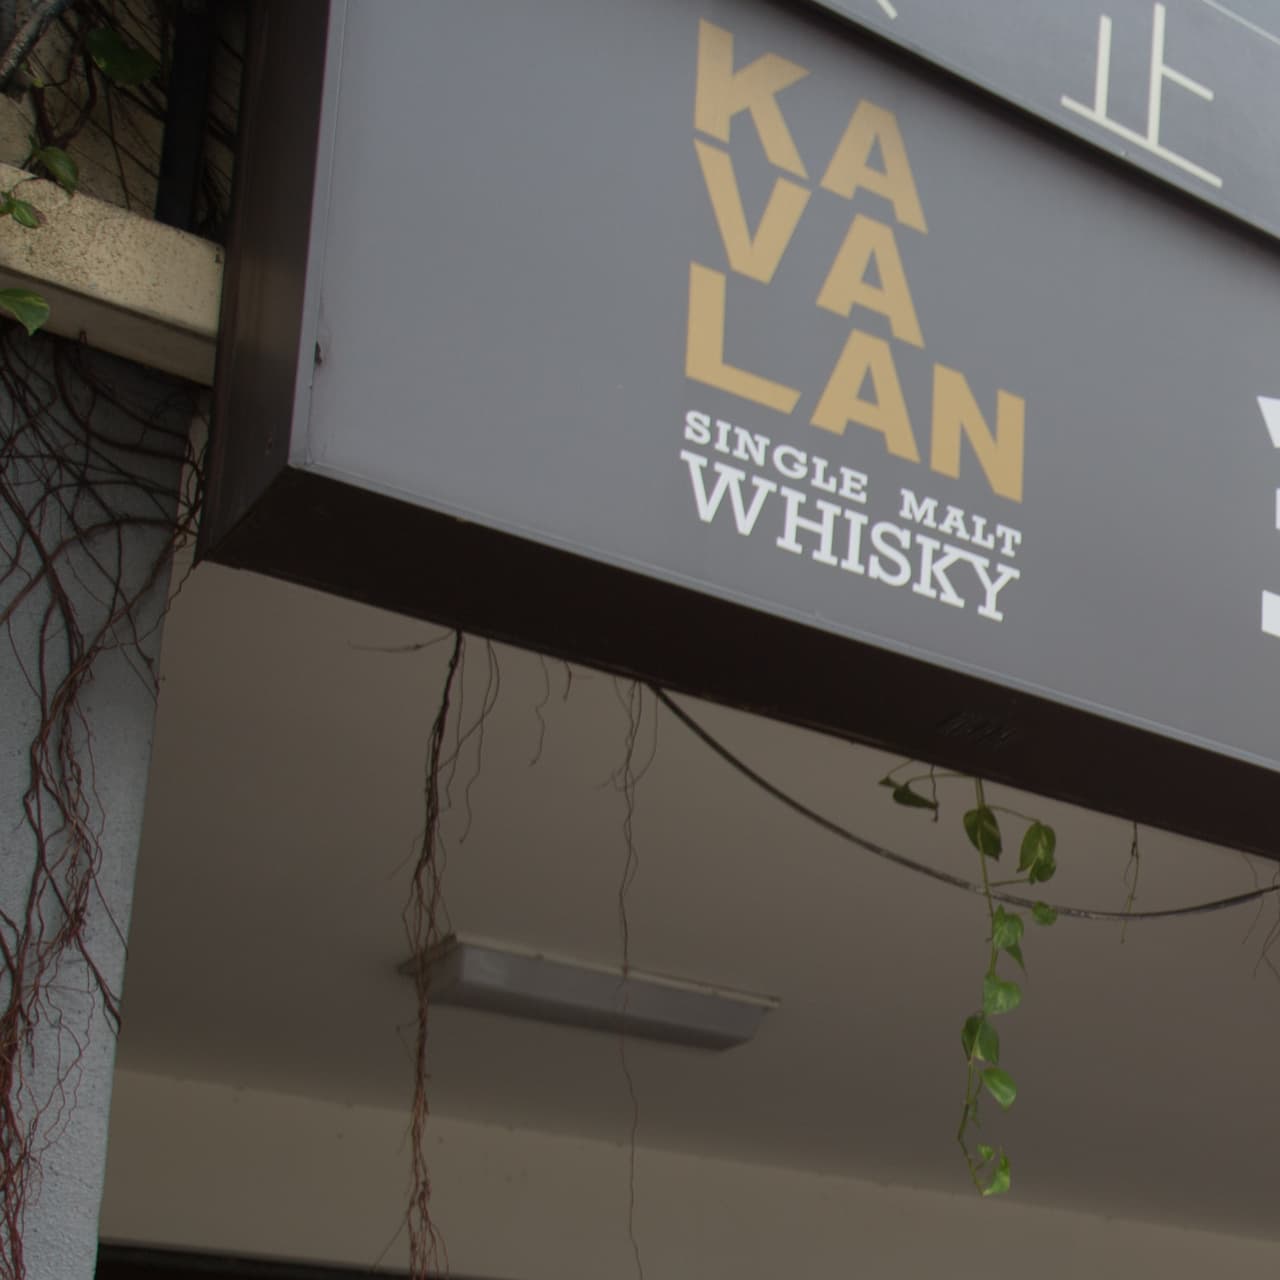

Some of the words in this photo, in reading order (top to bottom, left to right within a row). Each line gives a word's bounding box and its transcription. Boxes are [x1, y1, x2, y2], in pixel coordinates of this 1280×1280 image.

[680, 450, 1021, 623] WHISKY
[684, 411, 868, 505] SINGLE
[900, 489, 1022, 559] MALT
